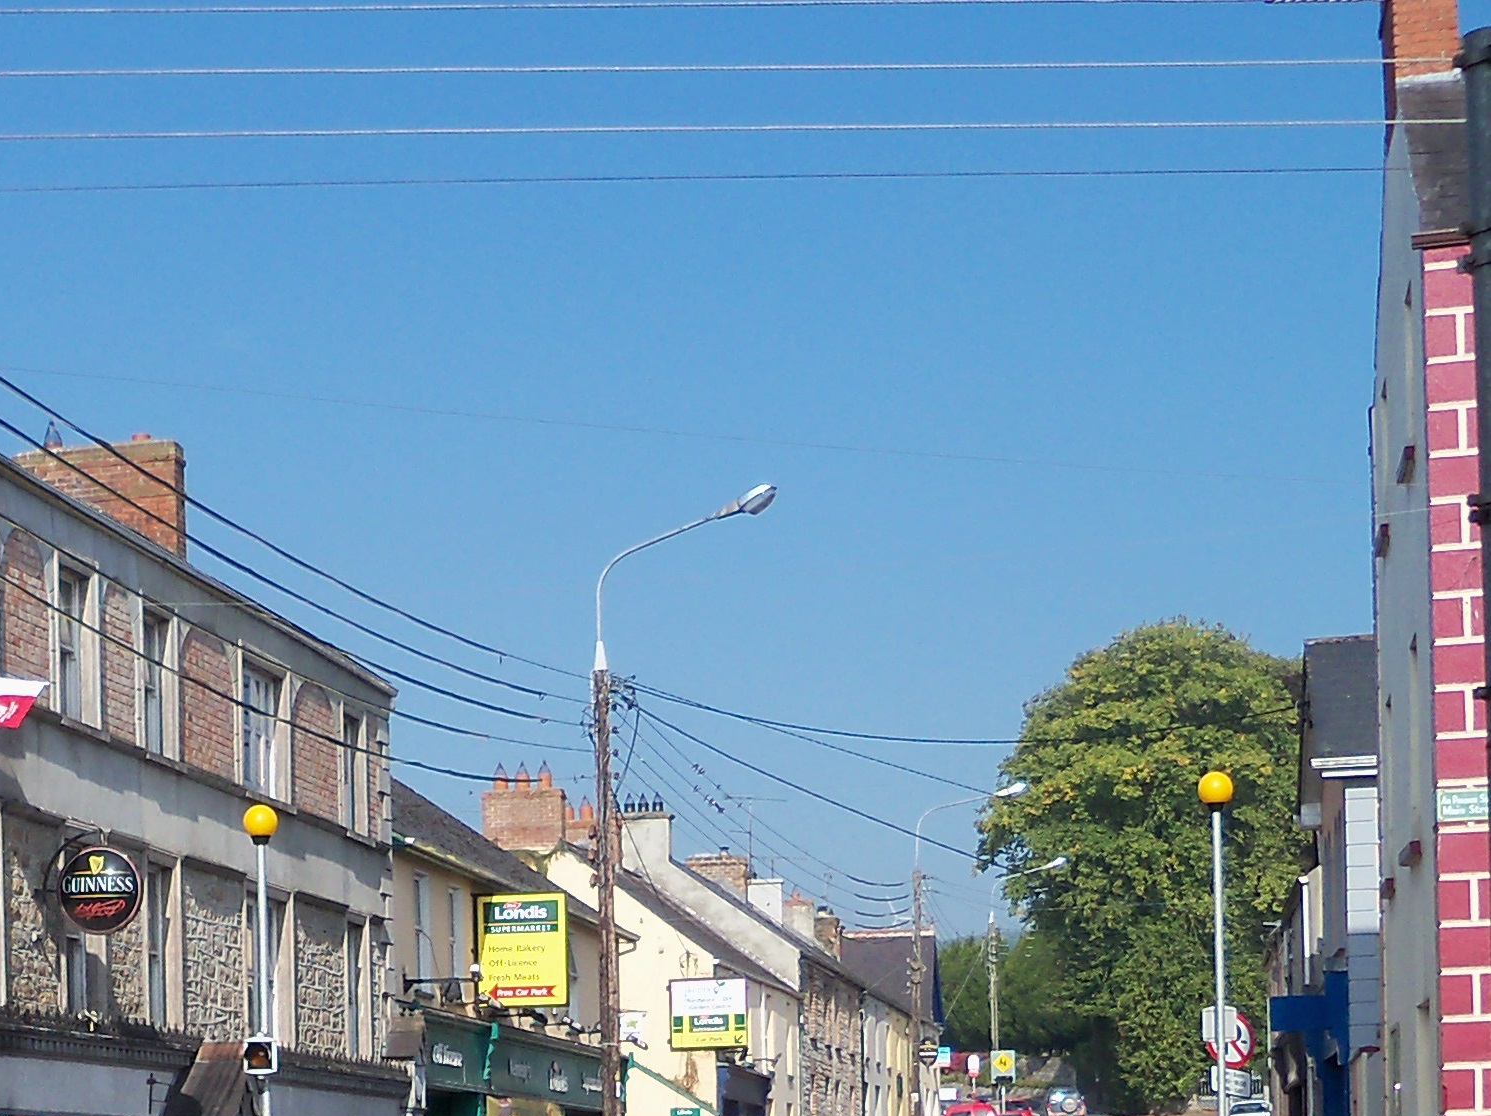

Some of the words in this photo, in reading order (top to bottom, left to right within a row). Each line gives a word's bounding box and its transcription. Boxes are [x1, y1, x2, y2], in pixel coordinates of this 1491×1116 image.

[62, 876, 134, 893] GUINNESS
[494, 905, 548, 920] Londis
[490, 925, 551, 933] SUPERMARKET
[516, 944, 546, 953] Bakery
[496, 989, 513, 997] Free
[515, 989, 528, 997] Car
[530, 988, 548, 996] Park
